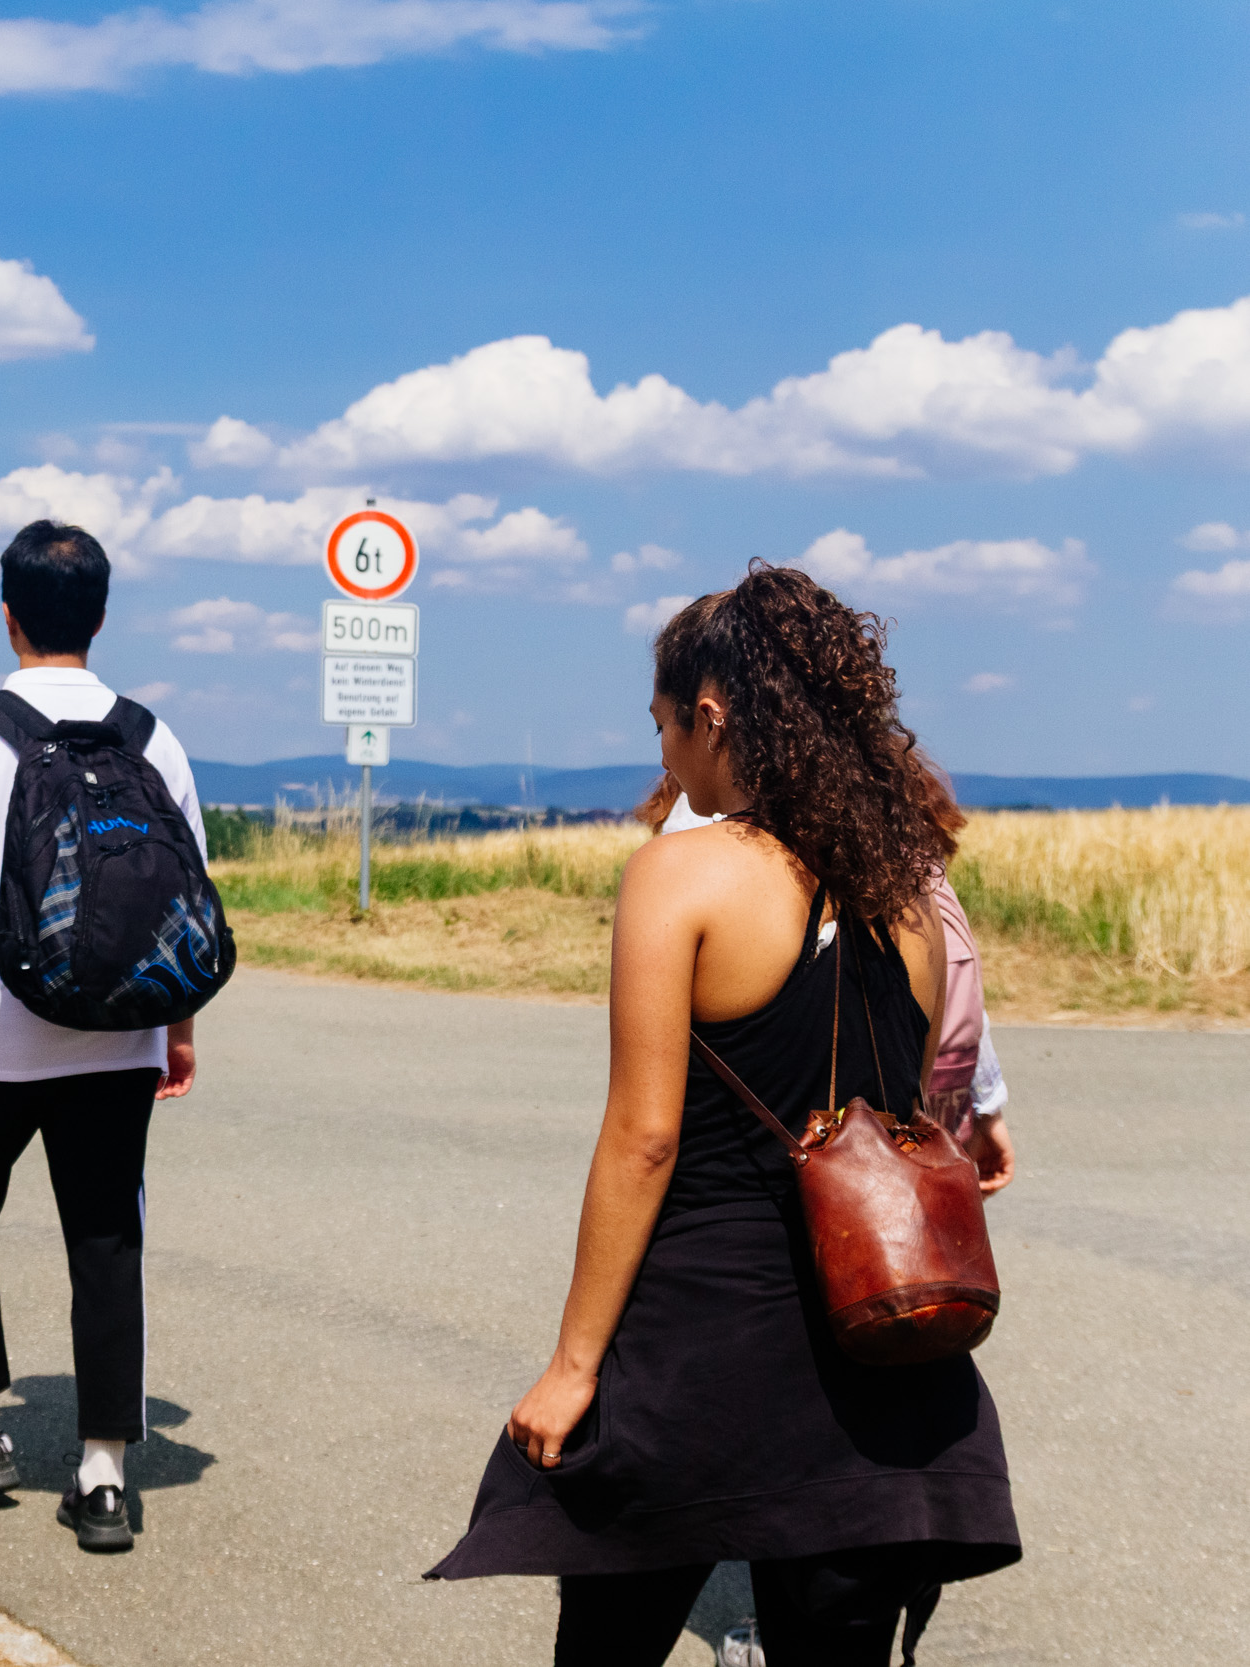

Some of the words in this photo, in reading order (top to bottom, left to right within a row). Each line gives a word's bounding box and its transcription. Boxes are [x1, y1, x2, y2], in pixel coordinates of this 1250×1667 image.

[334, 615, 408, 643] 500m
[387, 663, 404, 675] Weg
[354, 677, 406, 687] Winterdienst
[338, 692, 381, 704] Benutzung
[370, 707, 398, 717] Gefahr
